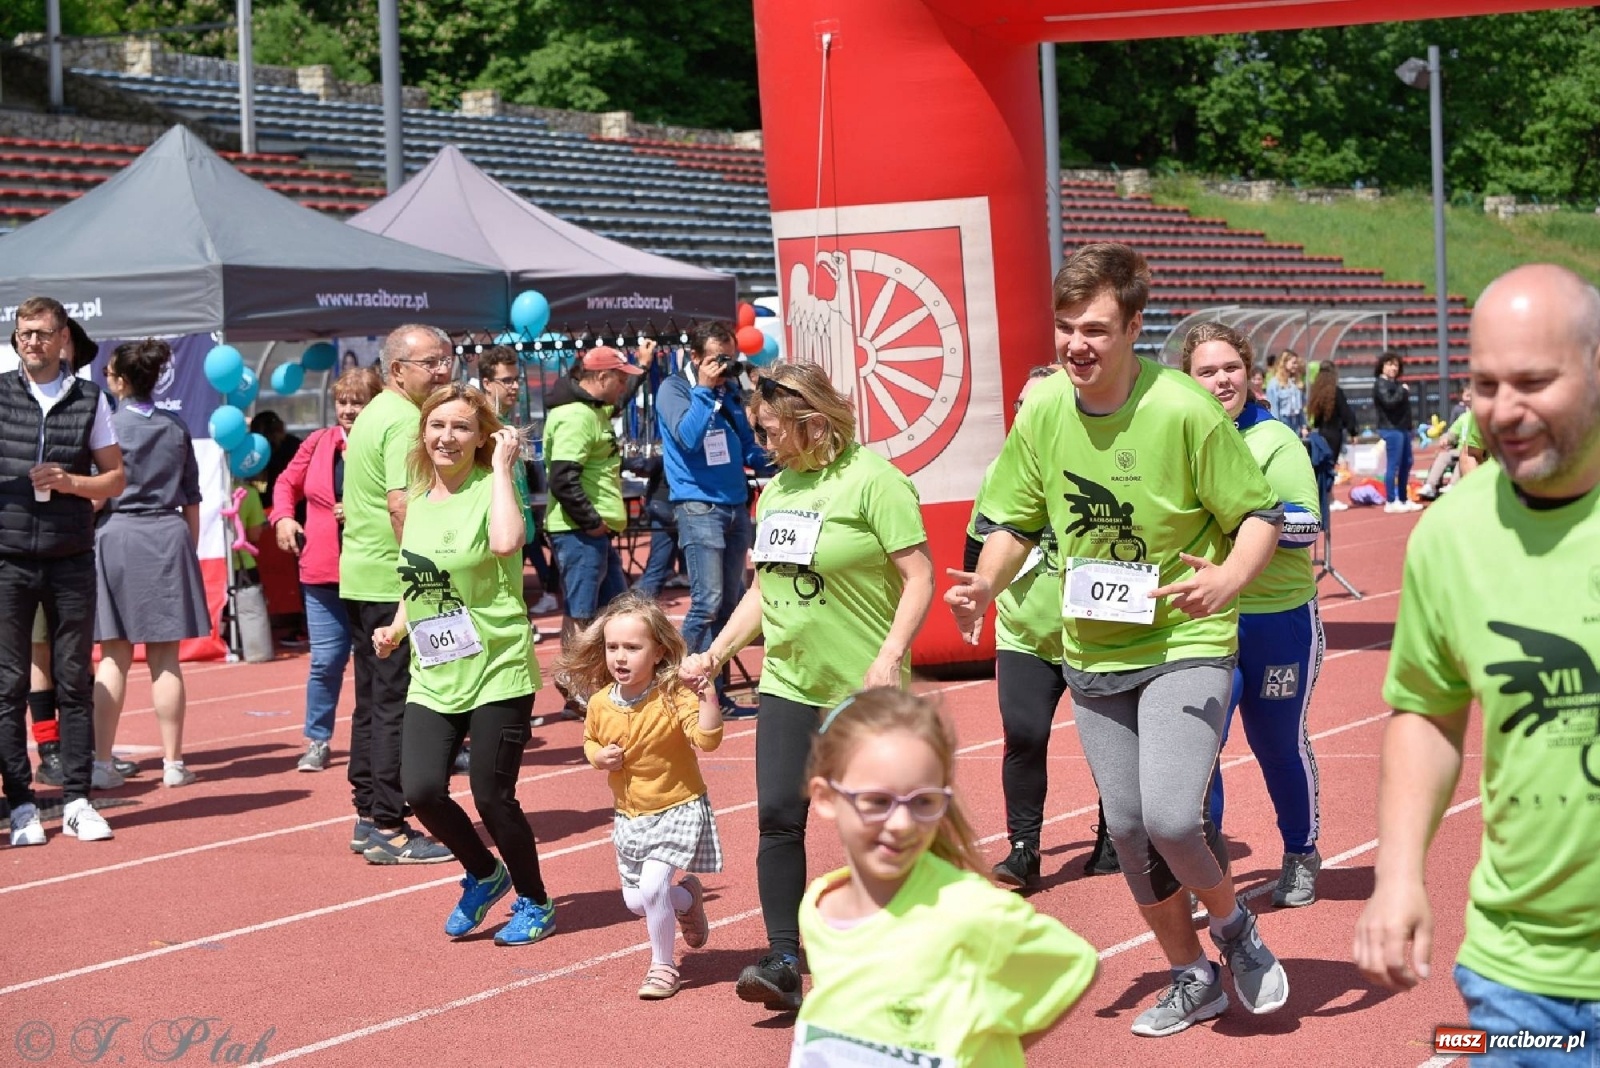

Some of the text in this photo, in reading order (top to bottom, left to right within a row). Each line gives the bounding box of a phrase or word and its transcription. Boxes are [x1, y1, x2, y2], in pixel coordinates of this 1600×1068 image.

[315, 288, 429, 312] www.raciborz.pl
[586, 291, 674, 313] www.raciborz.pl
[1087, 503, 1111, 517] VII
[769, 528, 797, 546] 034
[414, 571, 434, 582] VII
[1090, 581, 1130, 603] 072
[429, 629, 456, 649] 061
[1537, 667, 1583, 695] VII
